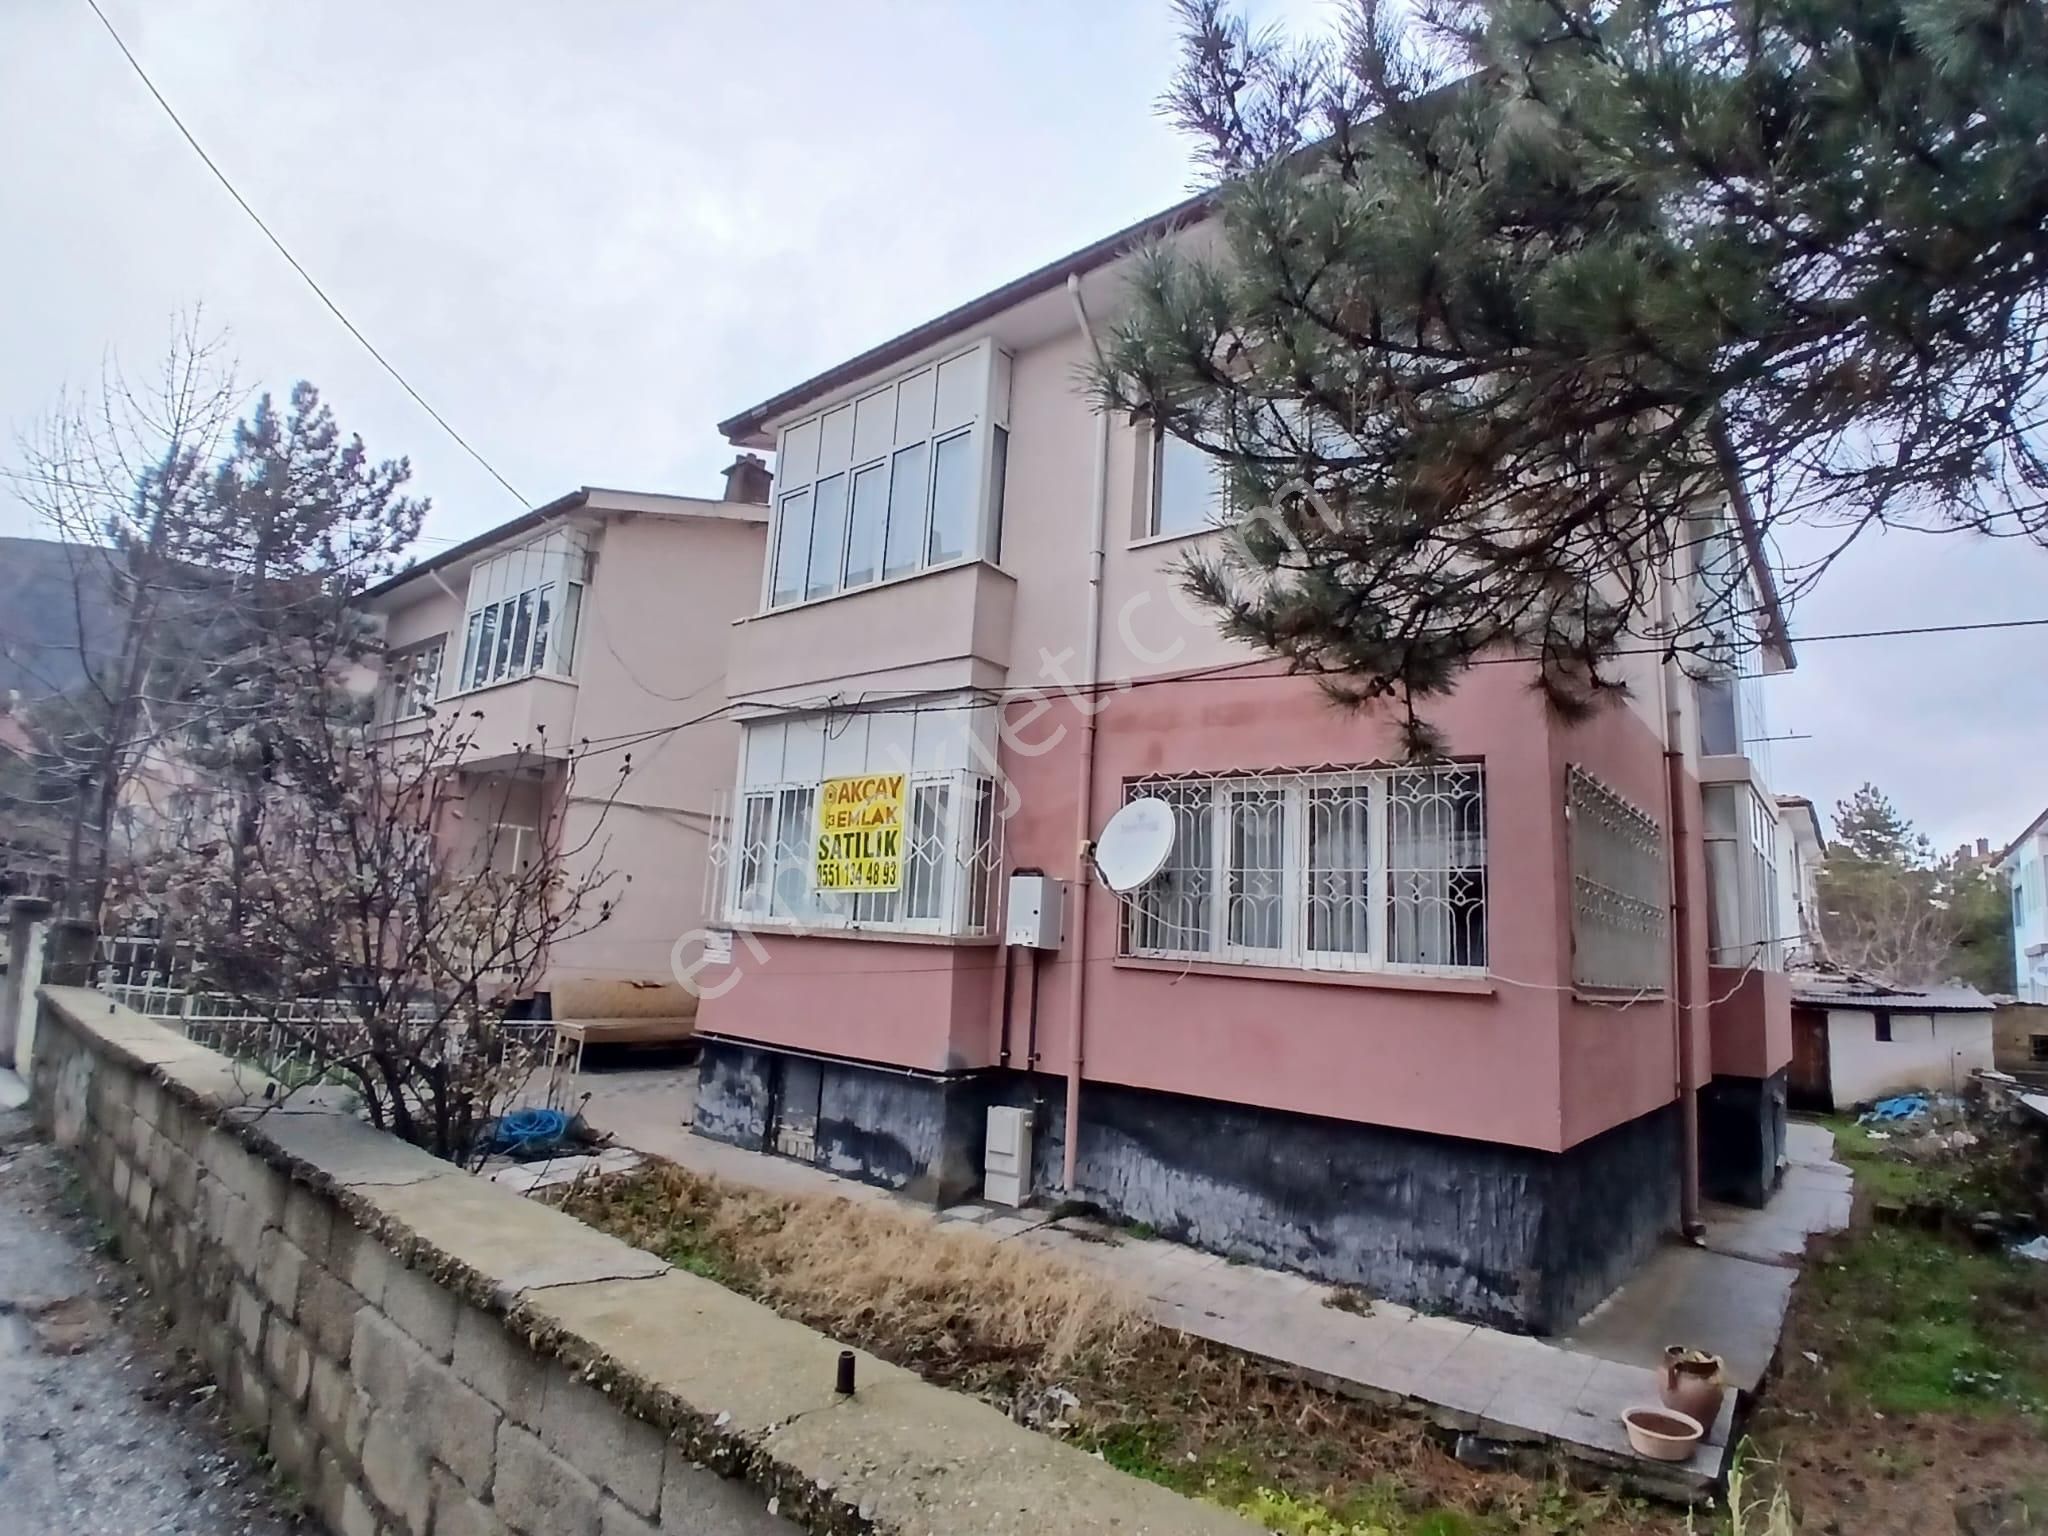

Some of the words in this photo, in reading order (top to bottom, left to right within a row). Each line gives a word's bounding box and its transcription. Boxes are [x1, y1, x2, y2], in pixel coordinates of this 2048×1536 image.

[838, 776, 902, 805] AKÇAY
[837, 806, 898, 828] EMLAK
[818, 830, 898, 860] SATILIK
[866, 861, 880, 886] 48
[883, 860, 897, 885] 93
